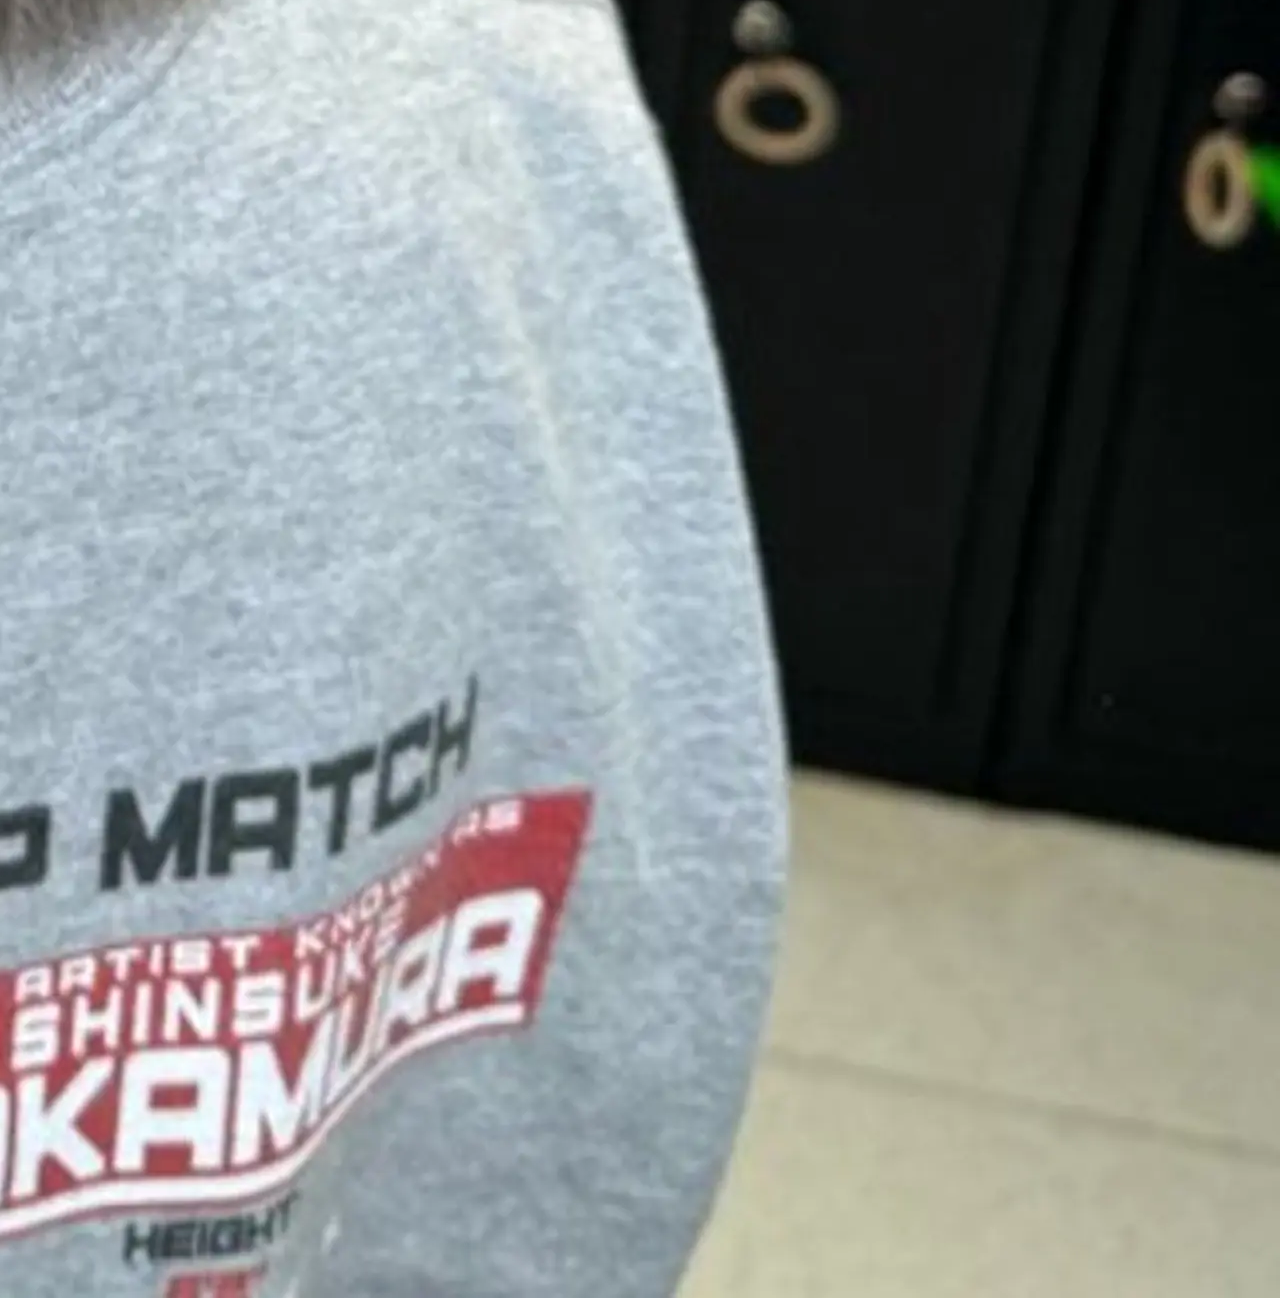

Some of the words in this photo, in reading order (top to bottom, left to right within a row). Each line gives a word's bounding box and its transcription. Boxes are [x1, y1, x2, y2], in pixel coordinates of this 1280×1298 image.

[100, 671, 479, 891] MATCH
[10, 896, 407, 1073] SHINSUKE
[14, 934, 261, 1003] ARTIST
